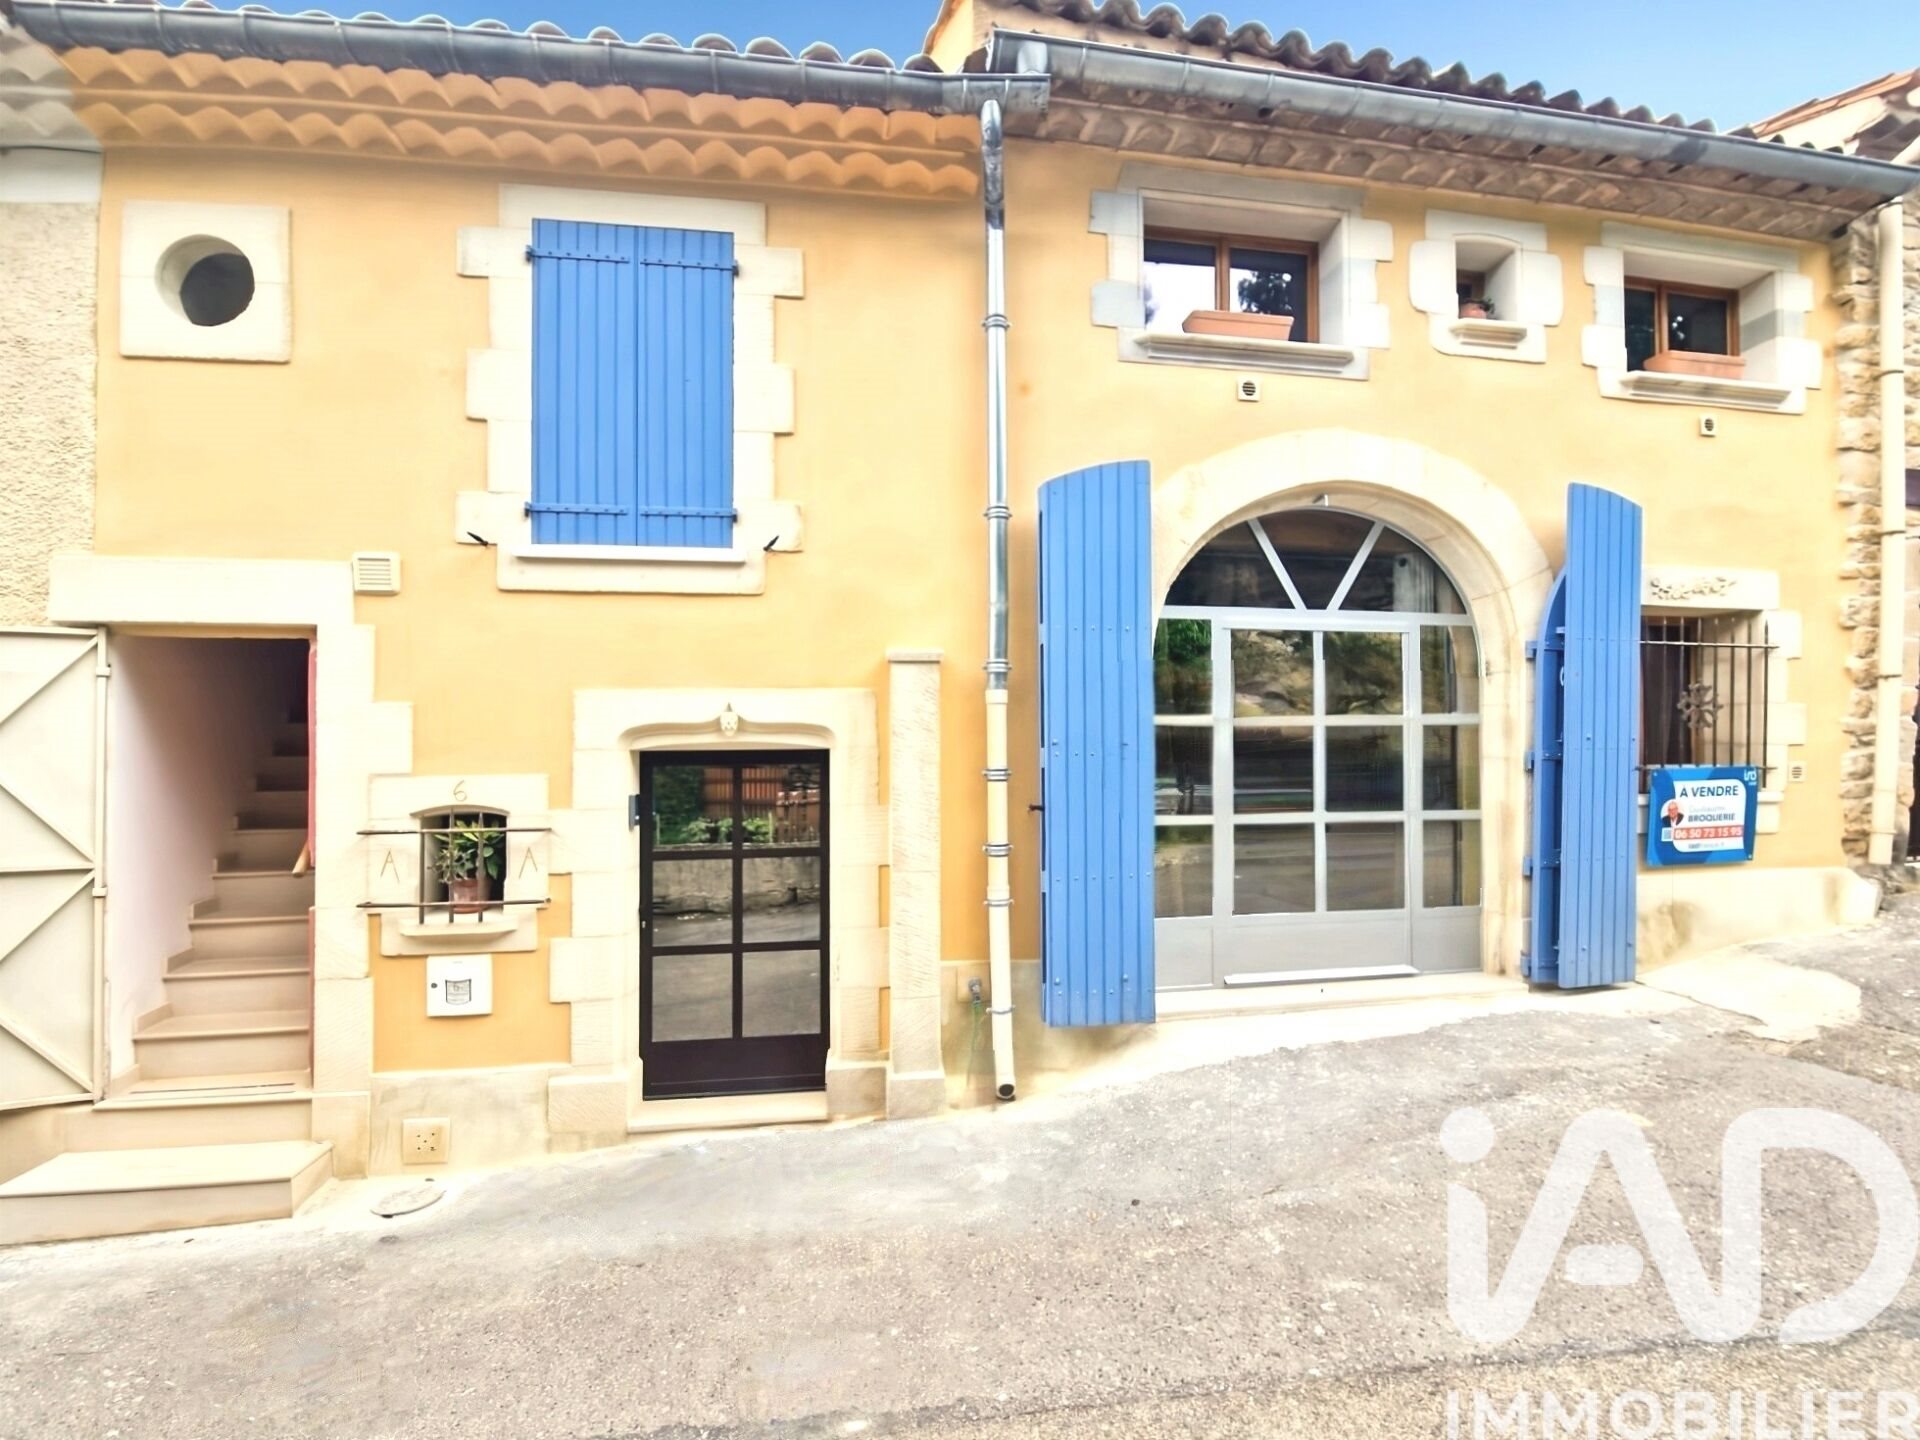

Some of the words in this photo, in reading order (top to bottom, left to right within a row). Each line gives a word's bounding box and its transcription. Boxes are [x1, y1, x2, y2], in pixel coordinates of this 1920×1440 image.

[453, 780, 467, 802] 6
[1691, 785, 1739, 797] VENDRE
[1675, 830, 1688, 839] 06
[1704, 828, 1716, 837] 73
[1718, 828, 1729, 837] 15
